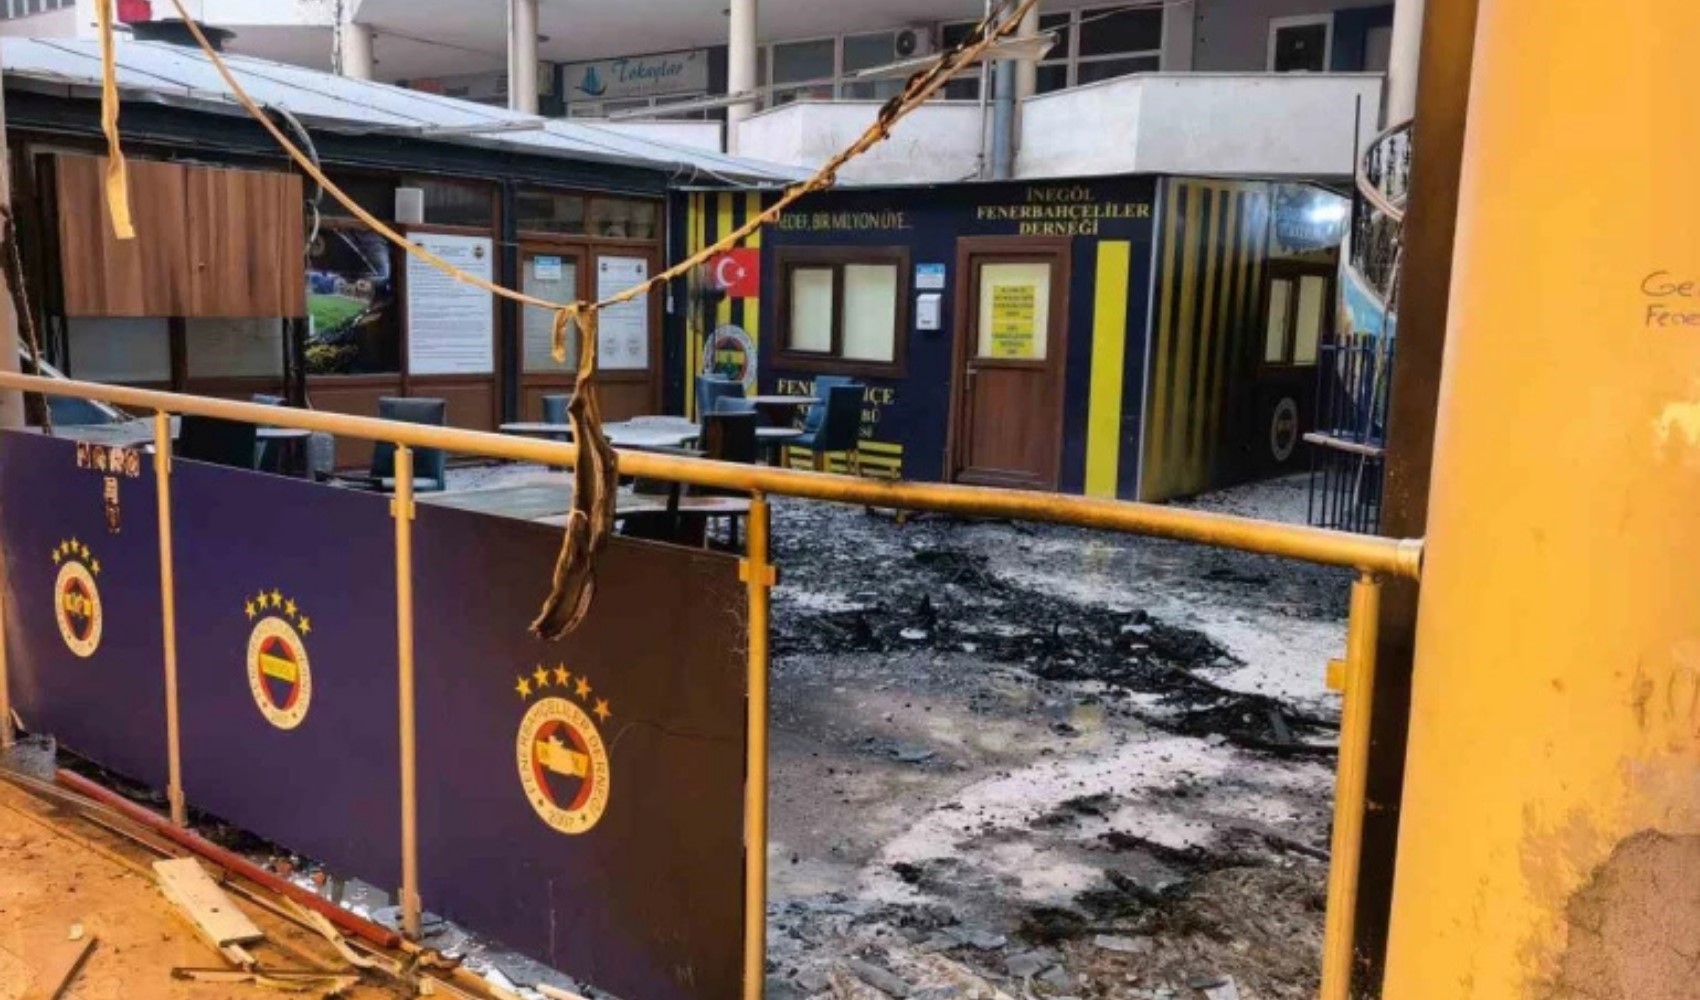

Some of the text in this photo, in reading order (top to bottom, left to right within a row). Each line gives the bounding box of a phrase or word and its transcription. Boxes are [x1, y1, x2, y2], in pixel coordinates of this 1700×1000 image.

[1026, 186, 1096, 202] İNEGÖL
[976, 202, 1150, 220] FENERBAHÇELİLER
[1018, 218, 1098, 236] DERNEĞİ
